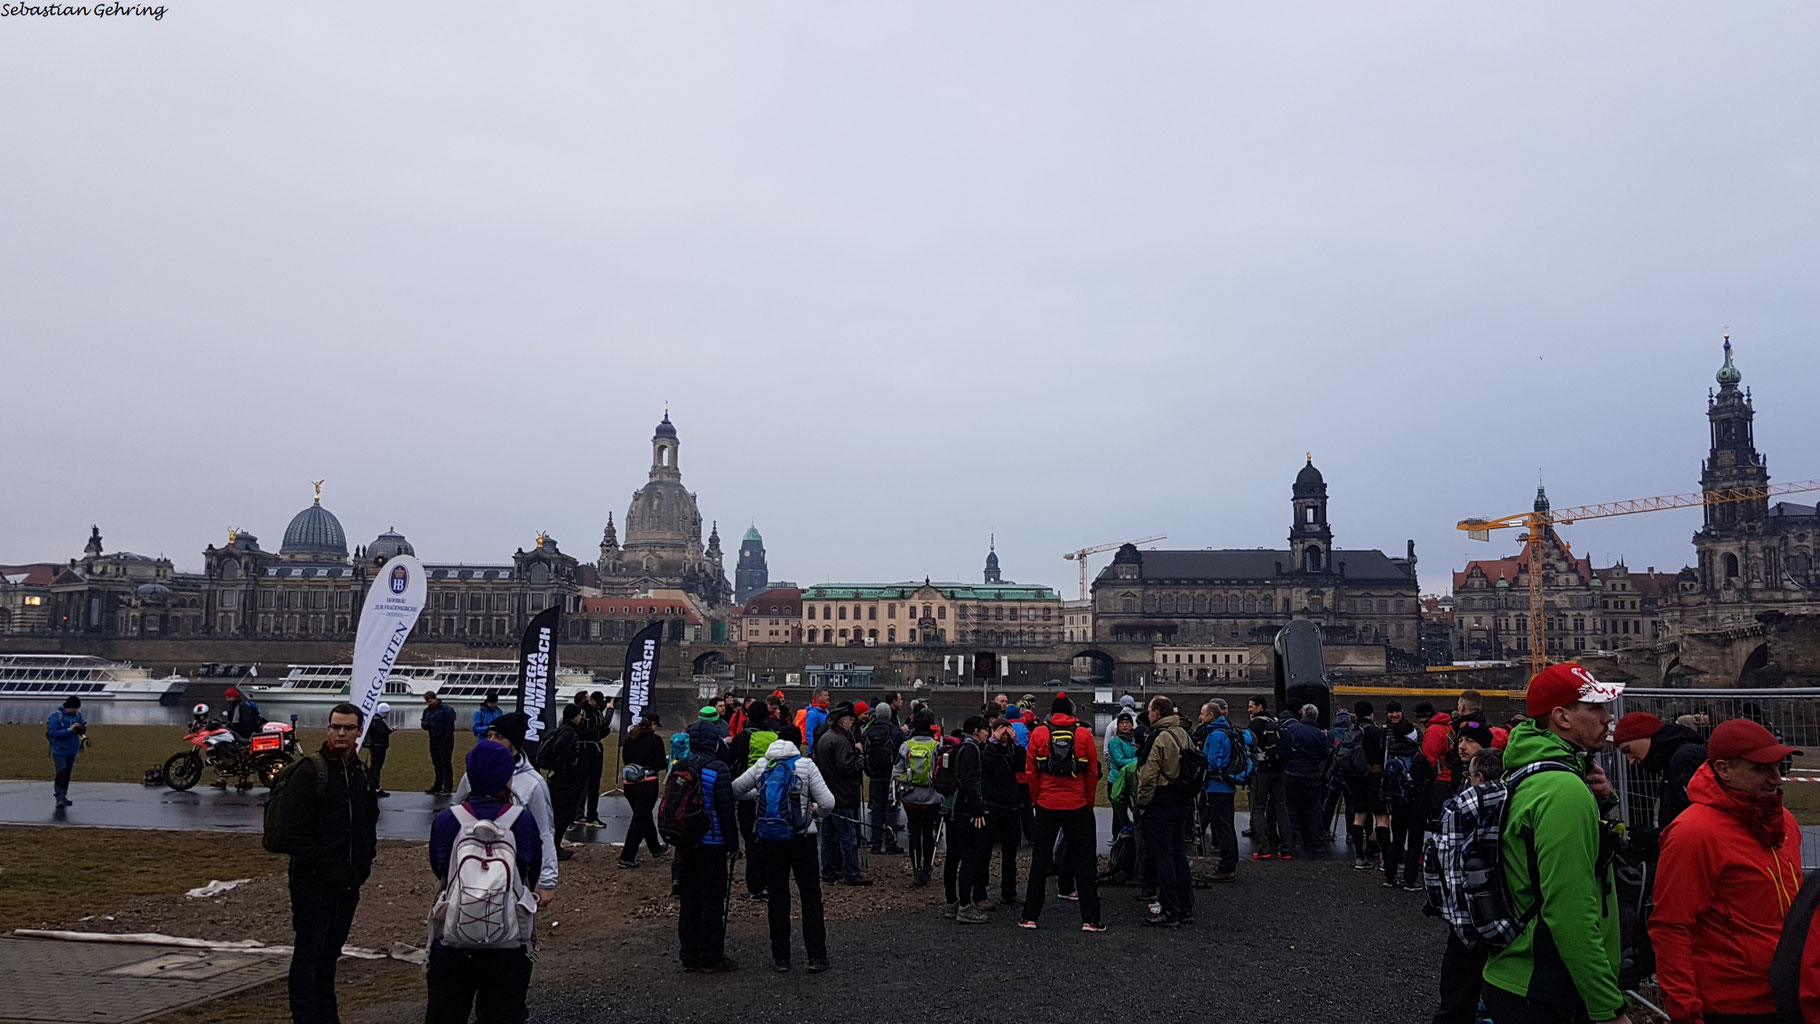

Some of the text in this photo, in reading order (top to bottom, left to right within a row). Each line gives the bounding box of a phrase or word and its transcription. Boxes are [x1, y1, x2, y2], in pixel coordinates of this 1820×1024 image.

[393, 578, 404, 591] HB
[362, 620, 408, 726] IERGARTEN
[524, 652, 539, 707] MEGA
[535, 627, 551, 708] MARSCH
[629, 660, 643, 705] MEGA
[639, 639, 656, 706] MARSCH
